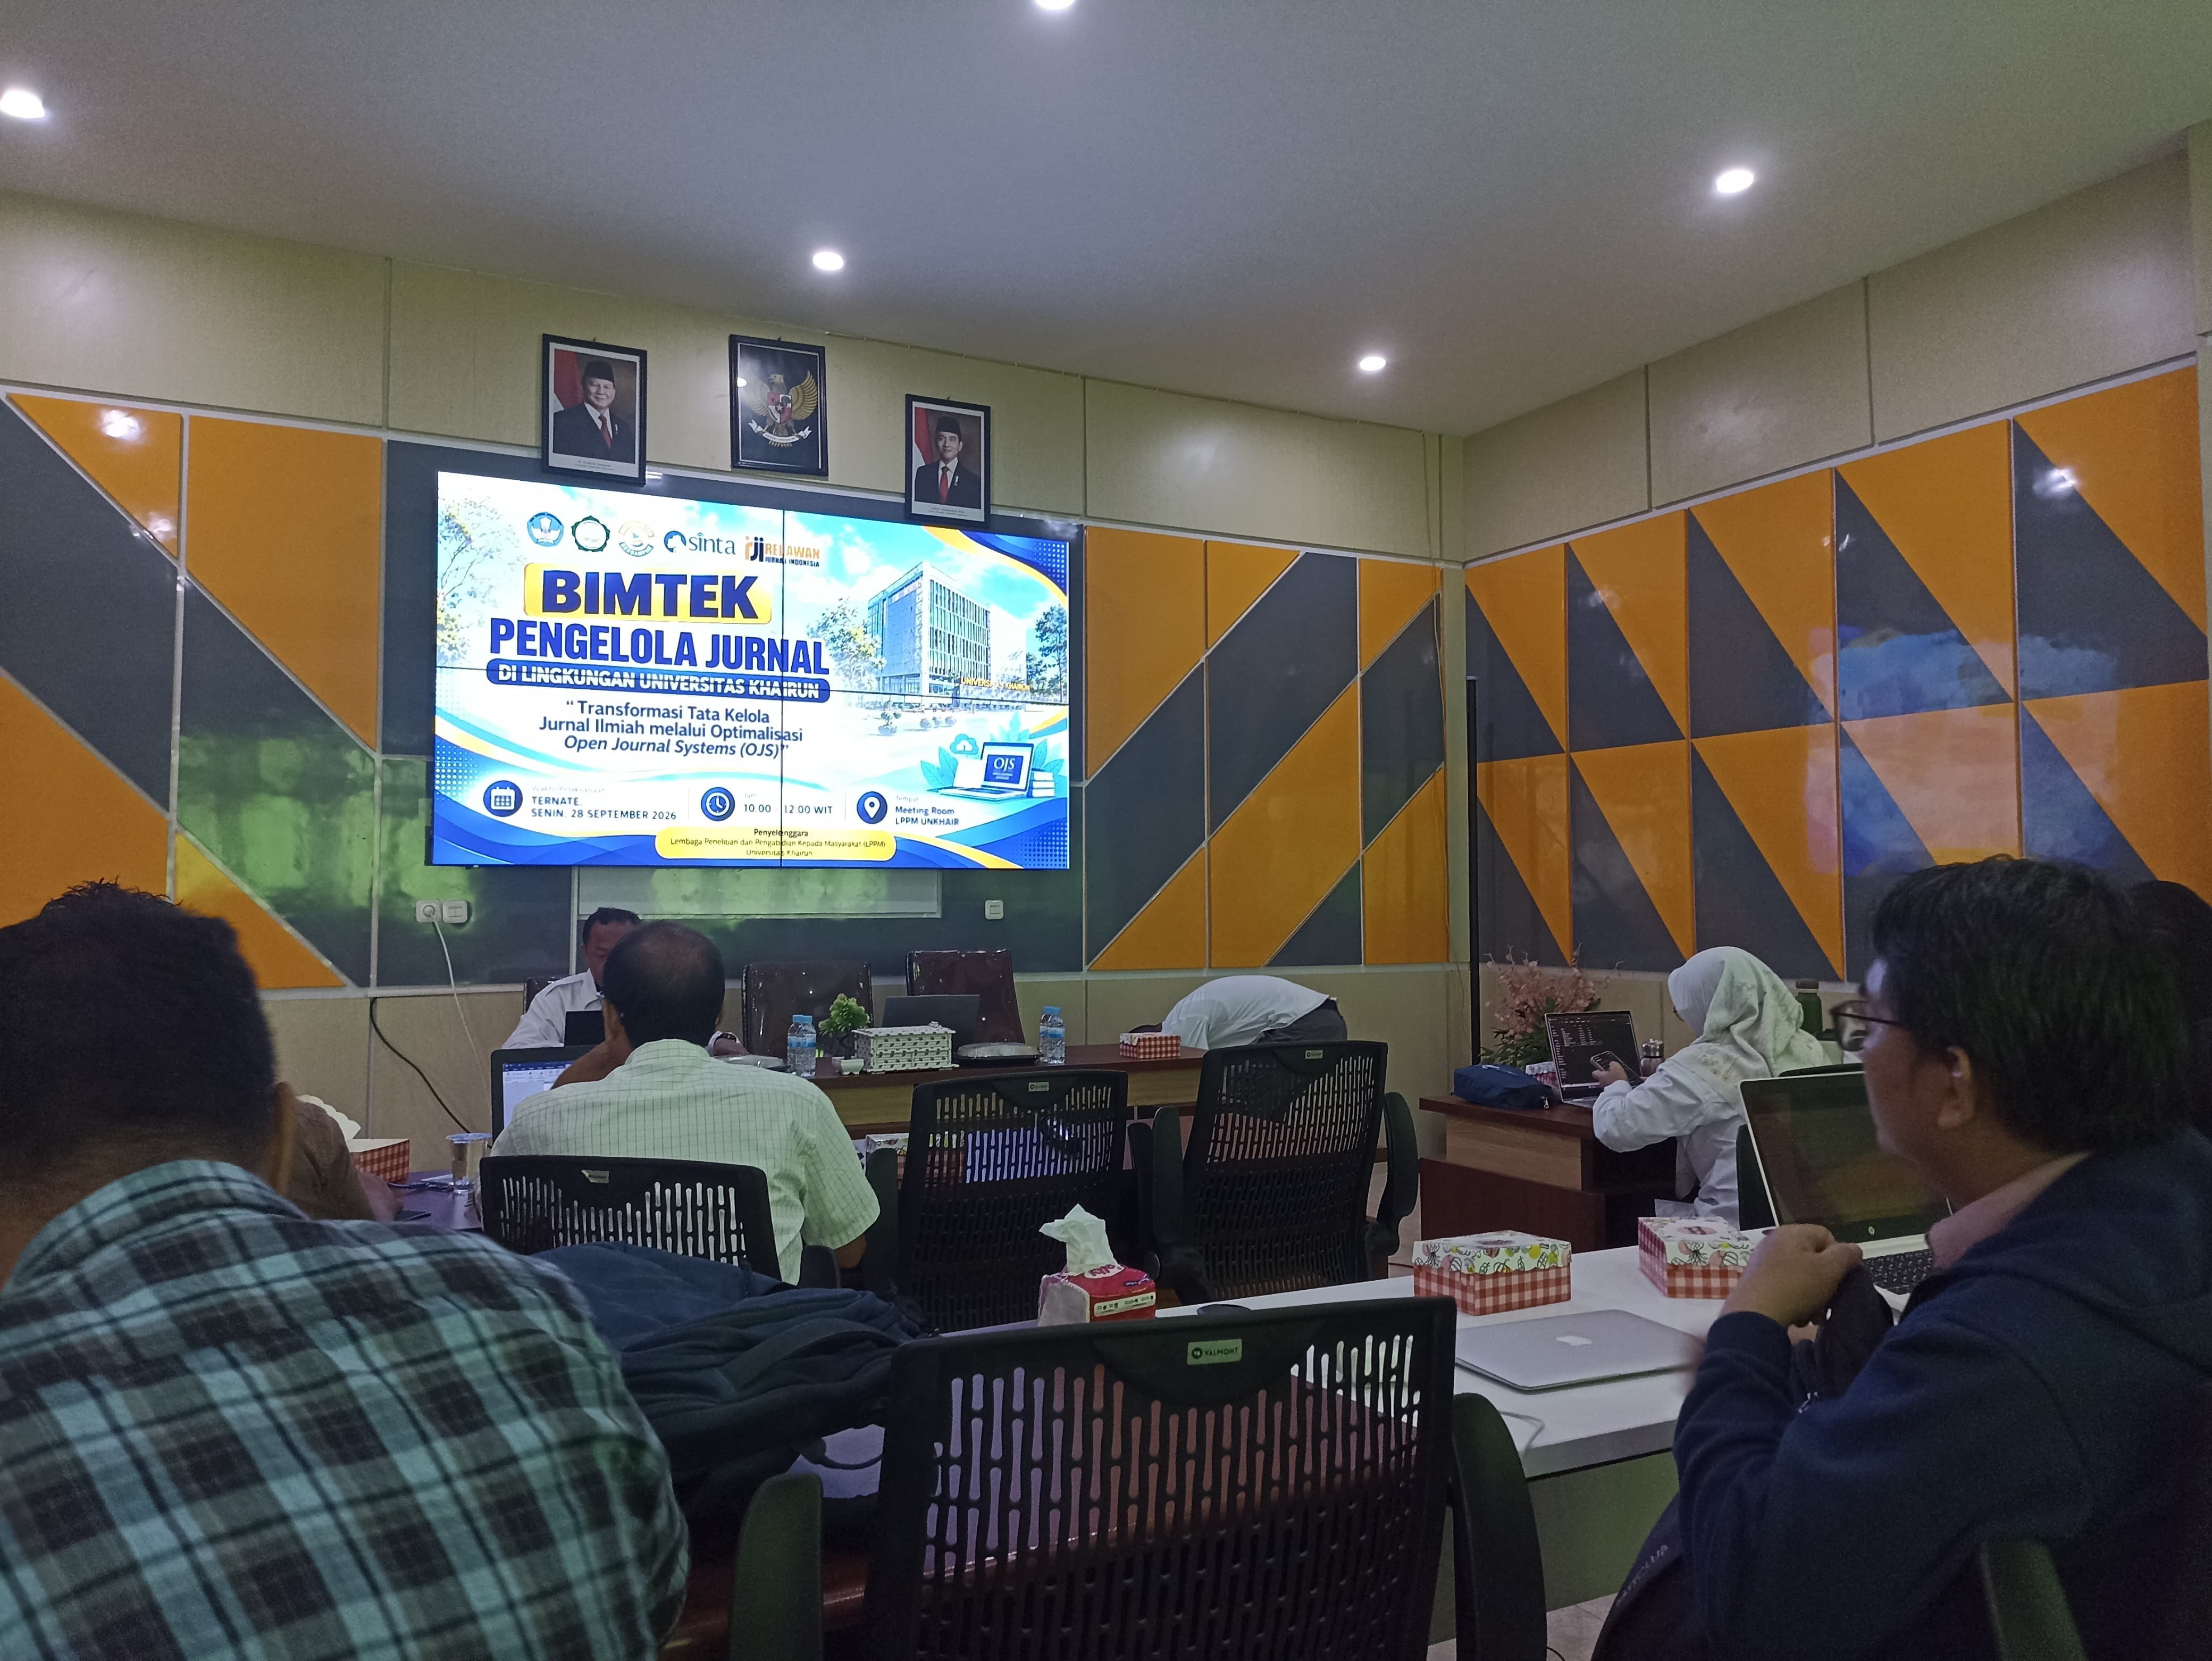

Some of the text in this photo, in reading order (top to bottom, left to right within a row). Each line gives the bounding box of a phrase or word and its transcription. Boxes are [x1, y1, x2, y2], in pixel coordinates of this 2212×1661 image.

[689, 532, 736, 555] sinta
[789, 558, 820, 567] INDONESIA
[542, 570, 759, 619] BIMTEK
[490, 617, 830, 675] PENGELOLA JURNAL
[498, 663, 819, 699] DI LINGKUNGAN UNIVERSITAS KHAIRUN
[577, 700, 683, 719] Transformasi
[688, 706, 720, 721] Tata
[725, 708, 769, 723] Kelola
[539, 716, 803, 742] Jurnal Ilmiah melalui Optimalisasi
[564, 734, 607, 752] Open
[611, 737, 670, 753] Journal
[674, 740, 736, 757] Systems
[993, 757, 1016, 772] OJS
[571, 809, 583, 818] 28
[587, 809, 648, 819] SEPTEMBER
[652, 811, 676, 820] 2026
[814, 805, 833, 814] WIT
[895, 806, 929, 816] Meeting
[671, 838, 702, 847] Lembaga
[1204, 1347, 1238, 1356] VALMONT
